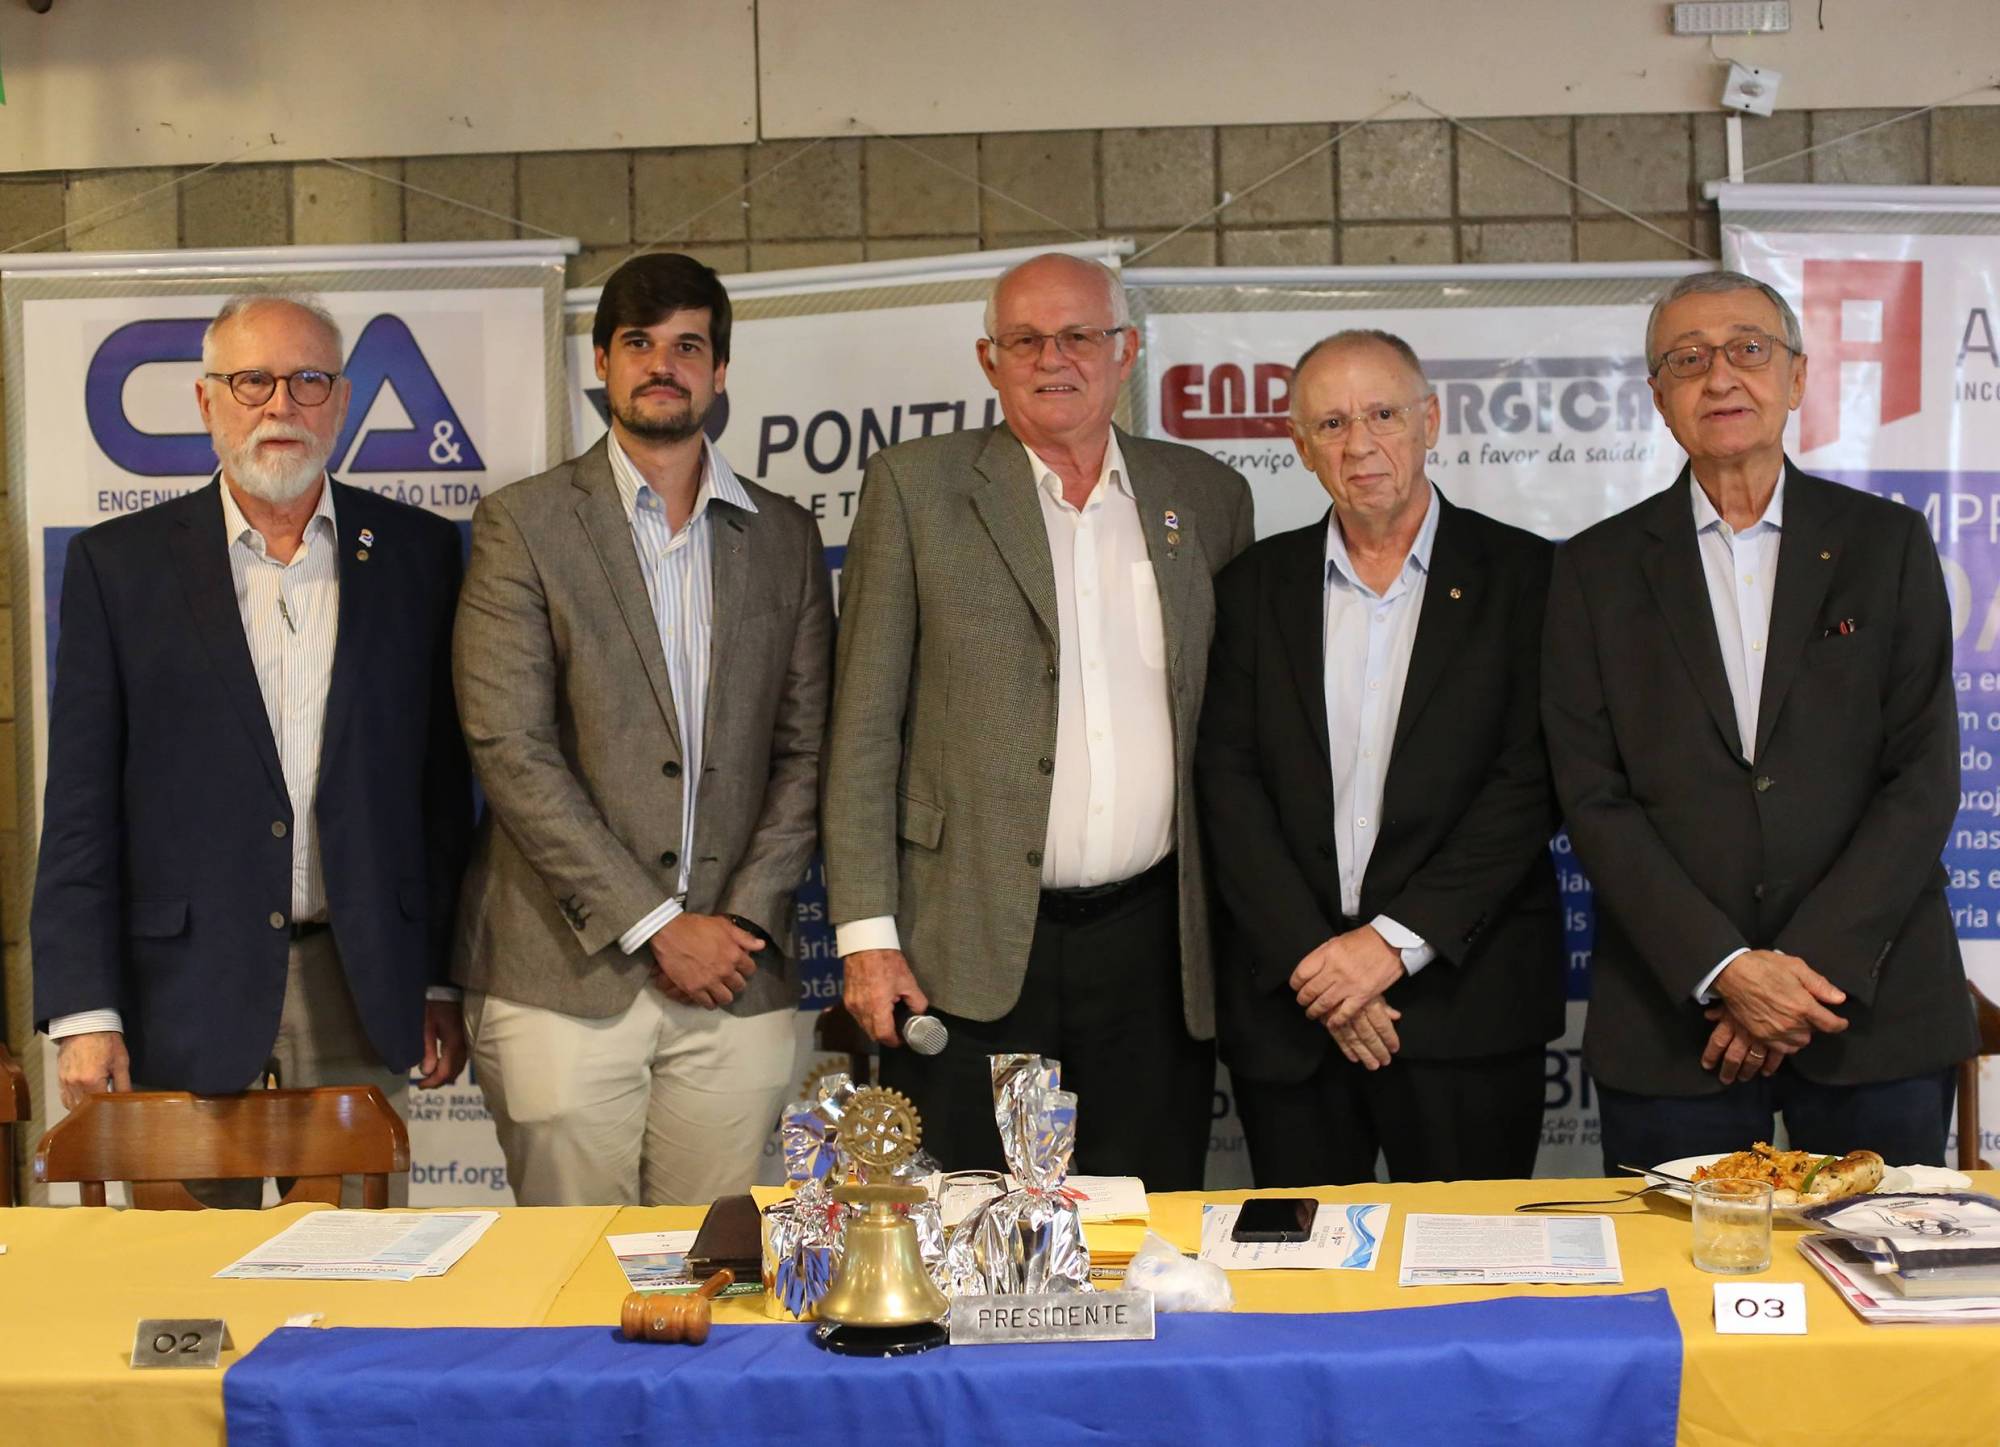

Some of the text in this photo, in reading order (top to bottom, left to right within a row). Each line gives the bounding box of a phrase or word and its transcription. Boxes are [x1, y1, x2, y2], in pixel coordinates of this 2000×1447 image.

[1458, 453, 1470, 465] a
[1480, 443, 1540, 465] favor
[1548, 444, 1575, 463] da
[431, 485, 481, 507] LTDA
[411, 1161, 505, 1191] btrf.org
[978, 1303, 1130, 1330] PRESIDENTE
[1735, 1297, 1785, 1319] 03
[153, 1332, 202, 1354] 02
